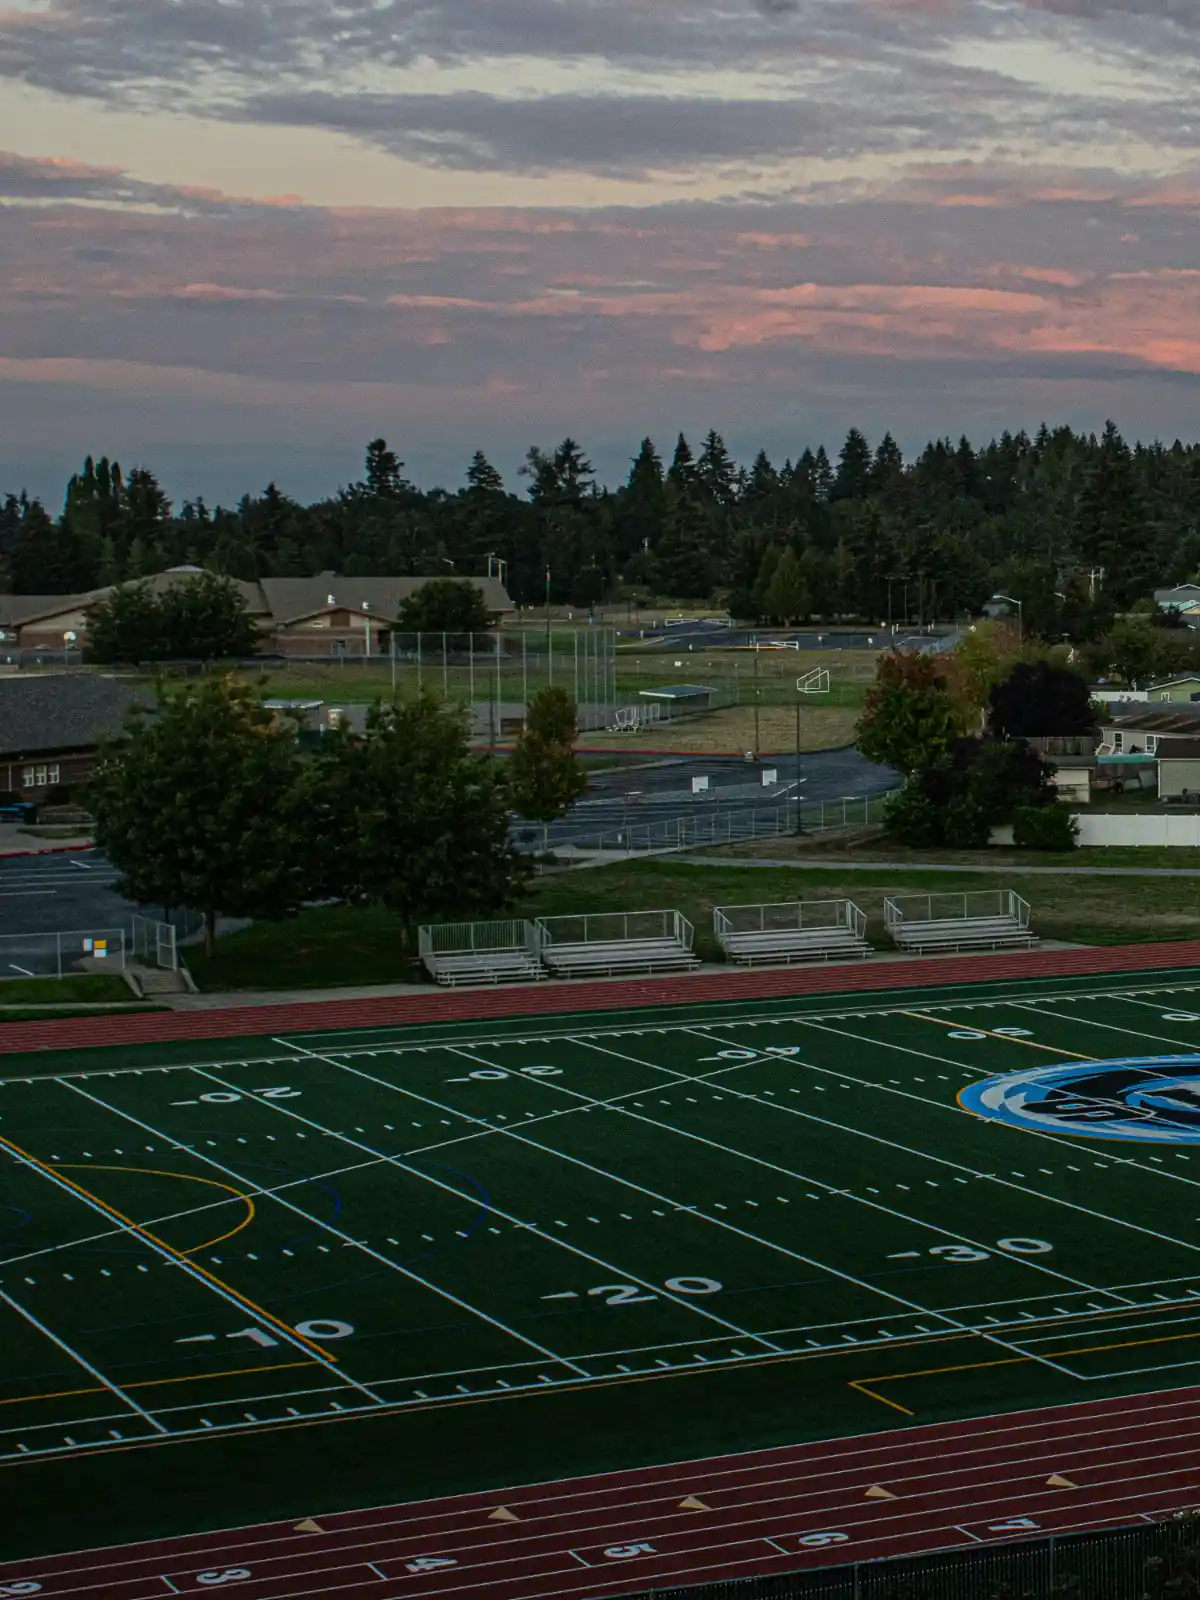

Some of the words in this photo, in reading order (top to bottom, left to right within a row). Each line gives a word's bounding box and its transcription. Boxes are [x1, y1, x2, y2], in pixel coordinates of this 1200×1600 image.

[947, 1026, 1035, 1041] 50
[716, 1046, 801, 1060] 40
[468, 1065, 564, 1081] 30
[199, 1086, 302, 1103] 20
[928, 1236, 1054, 1263] 30
[586, 1275, 724, 1306] 20
[225, 1318, 356, 1349] 10
[987, 1518, 1041, 1533] 7
[798, 1531, 850, 1547] 6
[603, 1542, 658, 1559] 5
[404, 1555, 459, 1574] 4
[196, 1567, 252, 1585] 3
